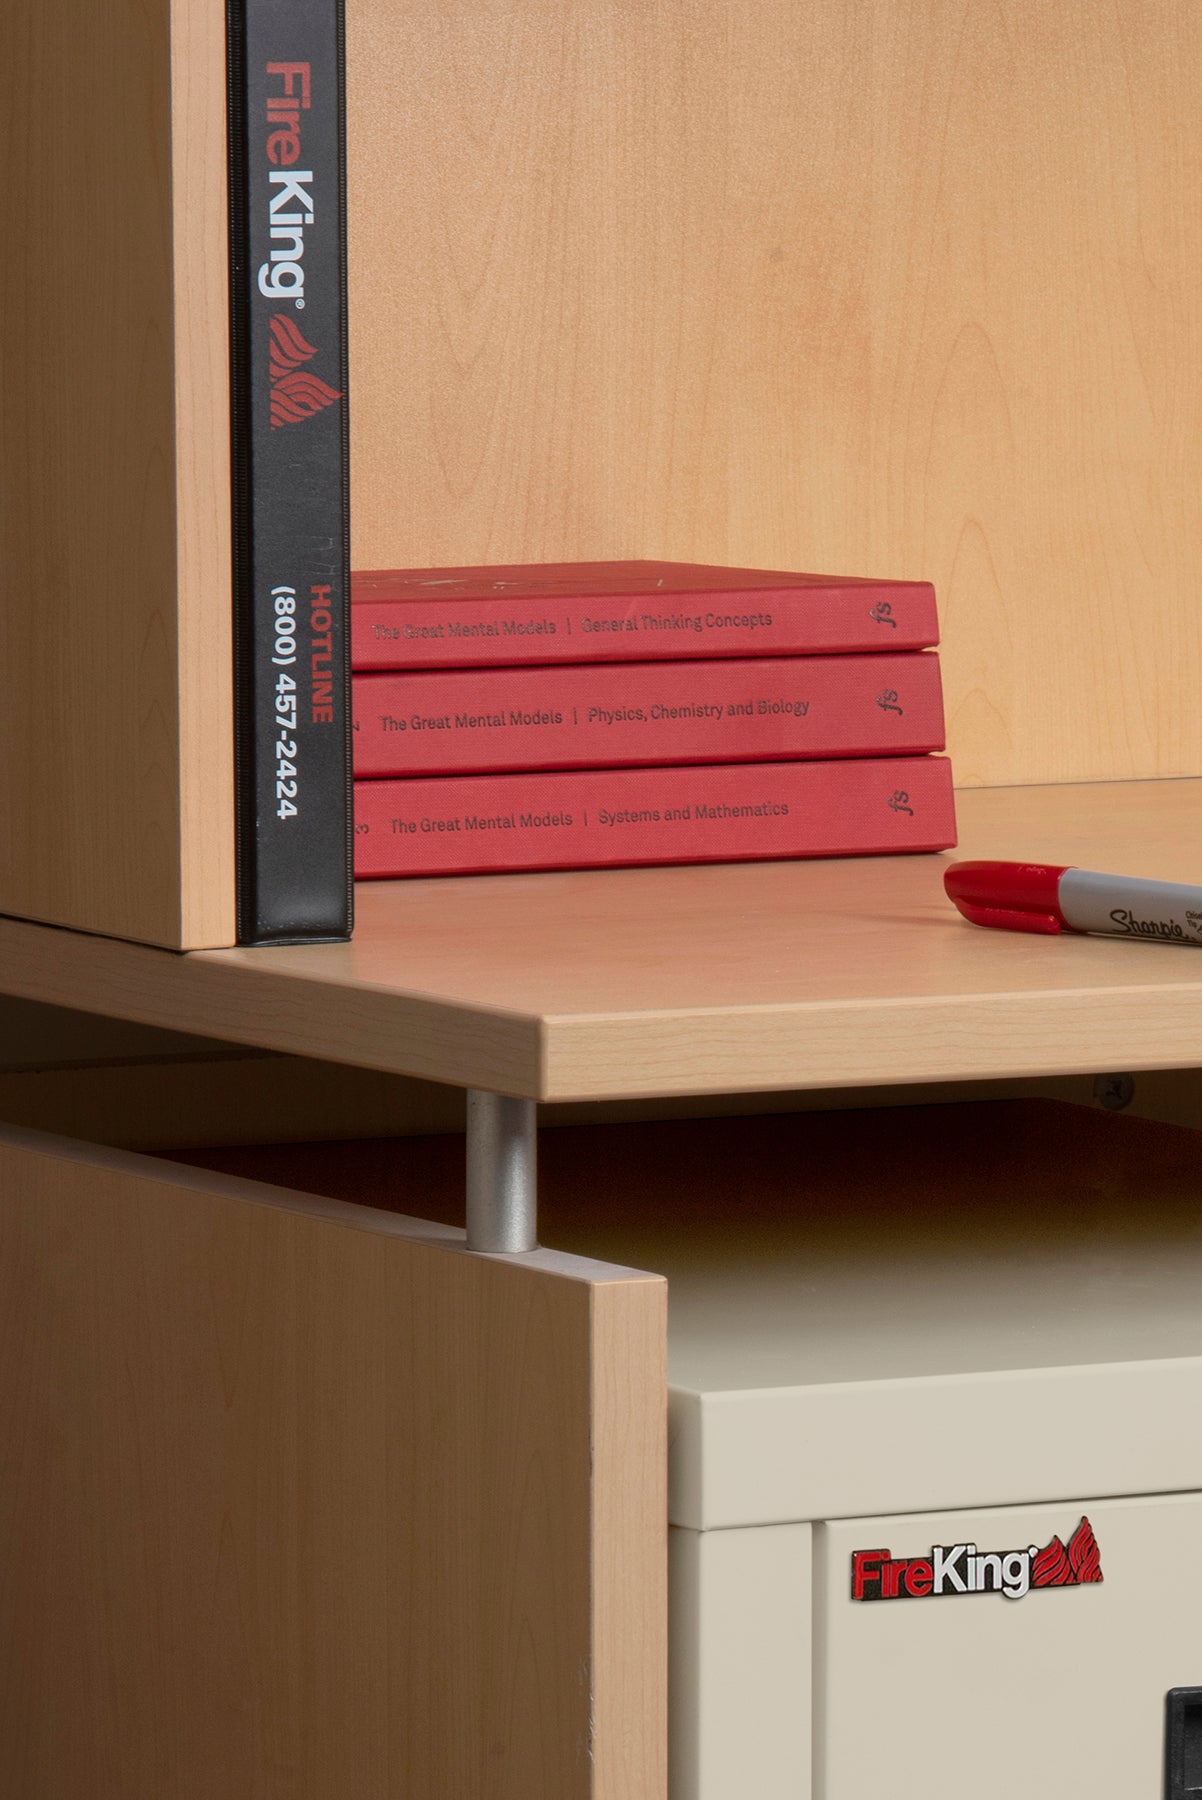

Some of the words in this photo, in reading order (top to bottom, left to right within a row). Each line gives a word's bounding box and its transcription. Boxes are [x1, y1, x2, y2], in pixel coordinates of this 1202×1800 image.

[271, 586, 297, 666] (800)
[310, 585, 334, 724] HOTLINE
[372, 624, 400, 640] The
[403, 623, 445, 639] Great
[448, 620, 500, 638] Mental
[503, 618, 556, 636] Models
[581, 615, 639, 634] General
[641, 614, 703, 632] Thinking
[705, 612, 773, 630] Concepts
[380, 715, 407, 732] The
[410, 714, 451, 731] Great
[455, 712, 506, 729] Mental
[510, 709, 563, 726] Models
[588, 706, 648, 725] Physics,
[651, 702, 724, 720] Chemistry
[727, 702, 753, 717] and
[757, 698, 810, 717] Biology
[275, 673, 298, 820] 457-2424
[389, 818, 417, 834] The
[420, 817, 461, 833] Great
[465, 815, 516, 831] Mental
[520, 811, 573, 828] Models
[598, 808, 660, 827] Systems
[664, 806, 690, 822] and
[695, 801, 789, 820] Mathematics
